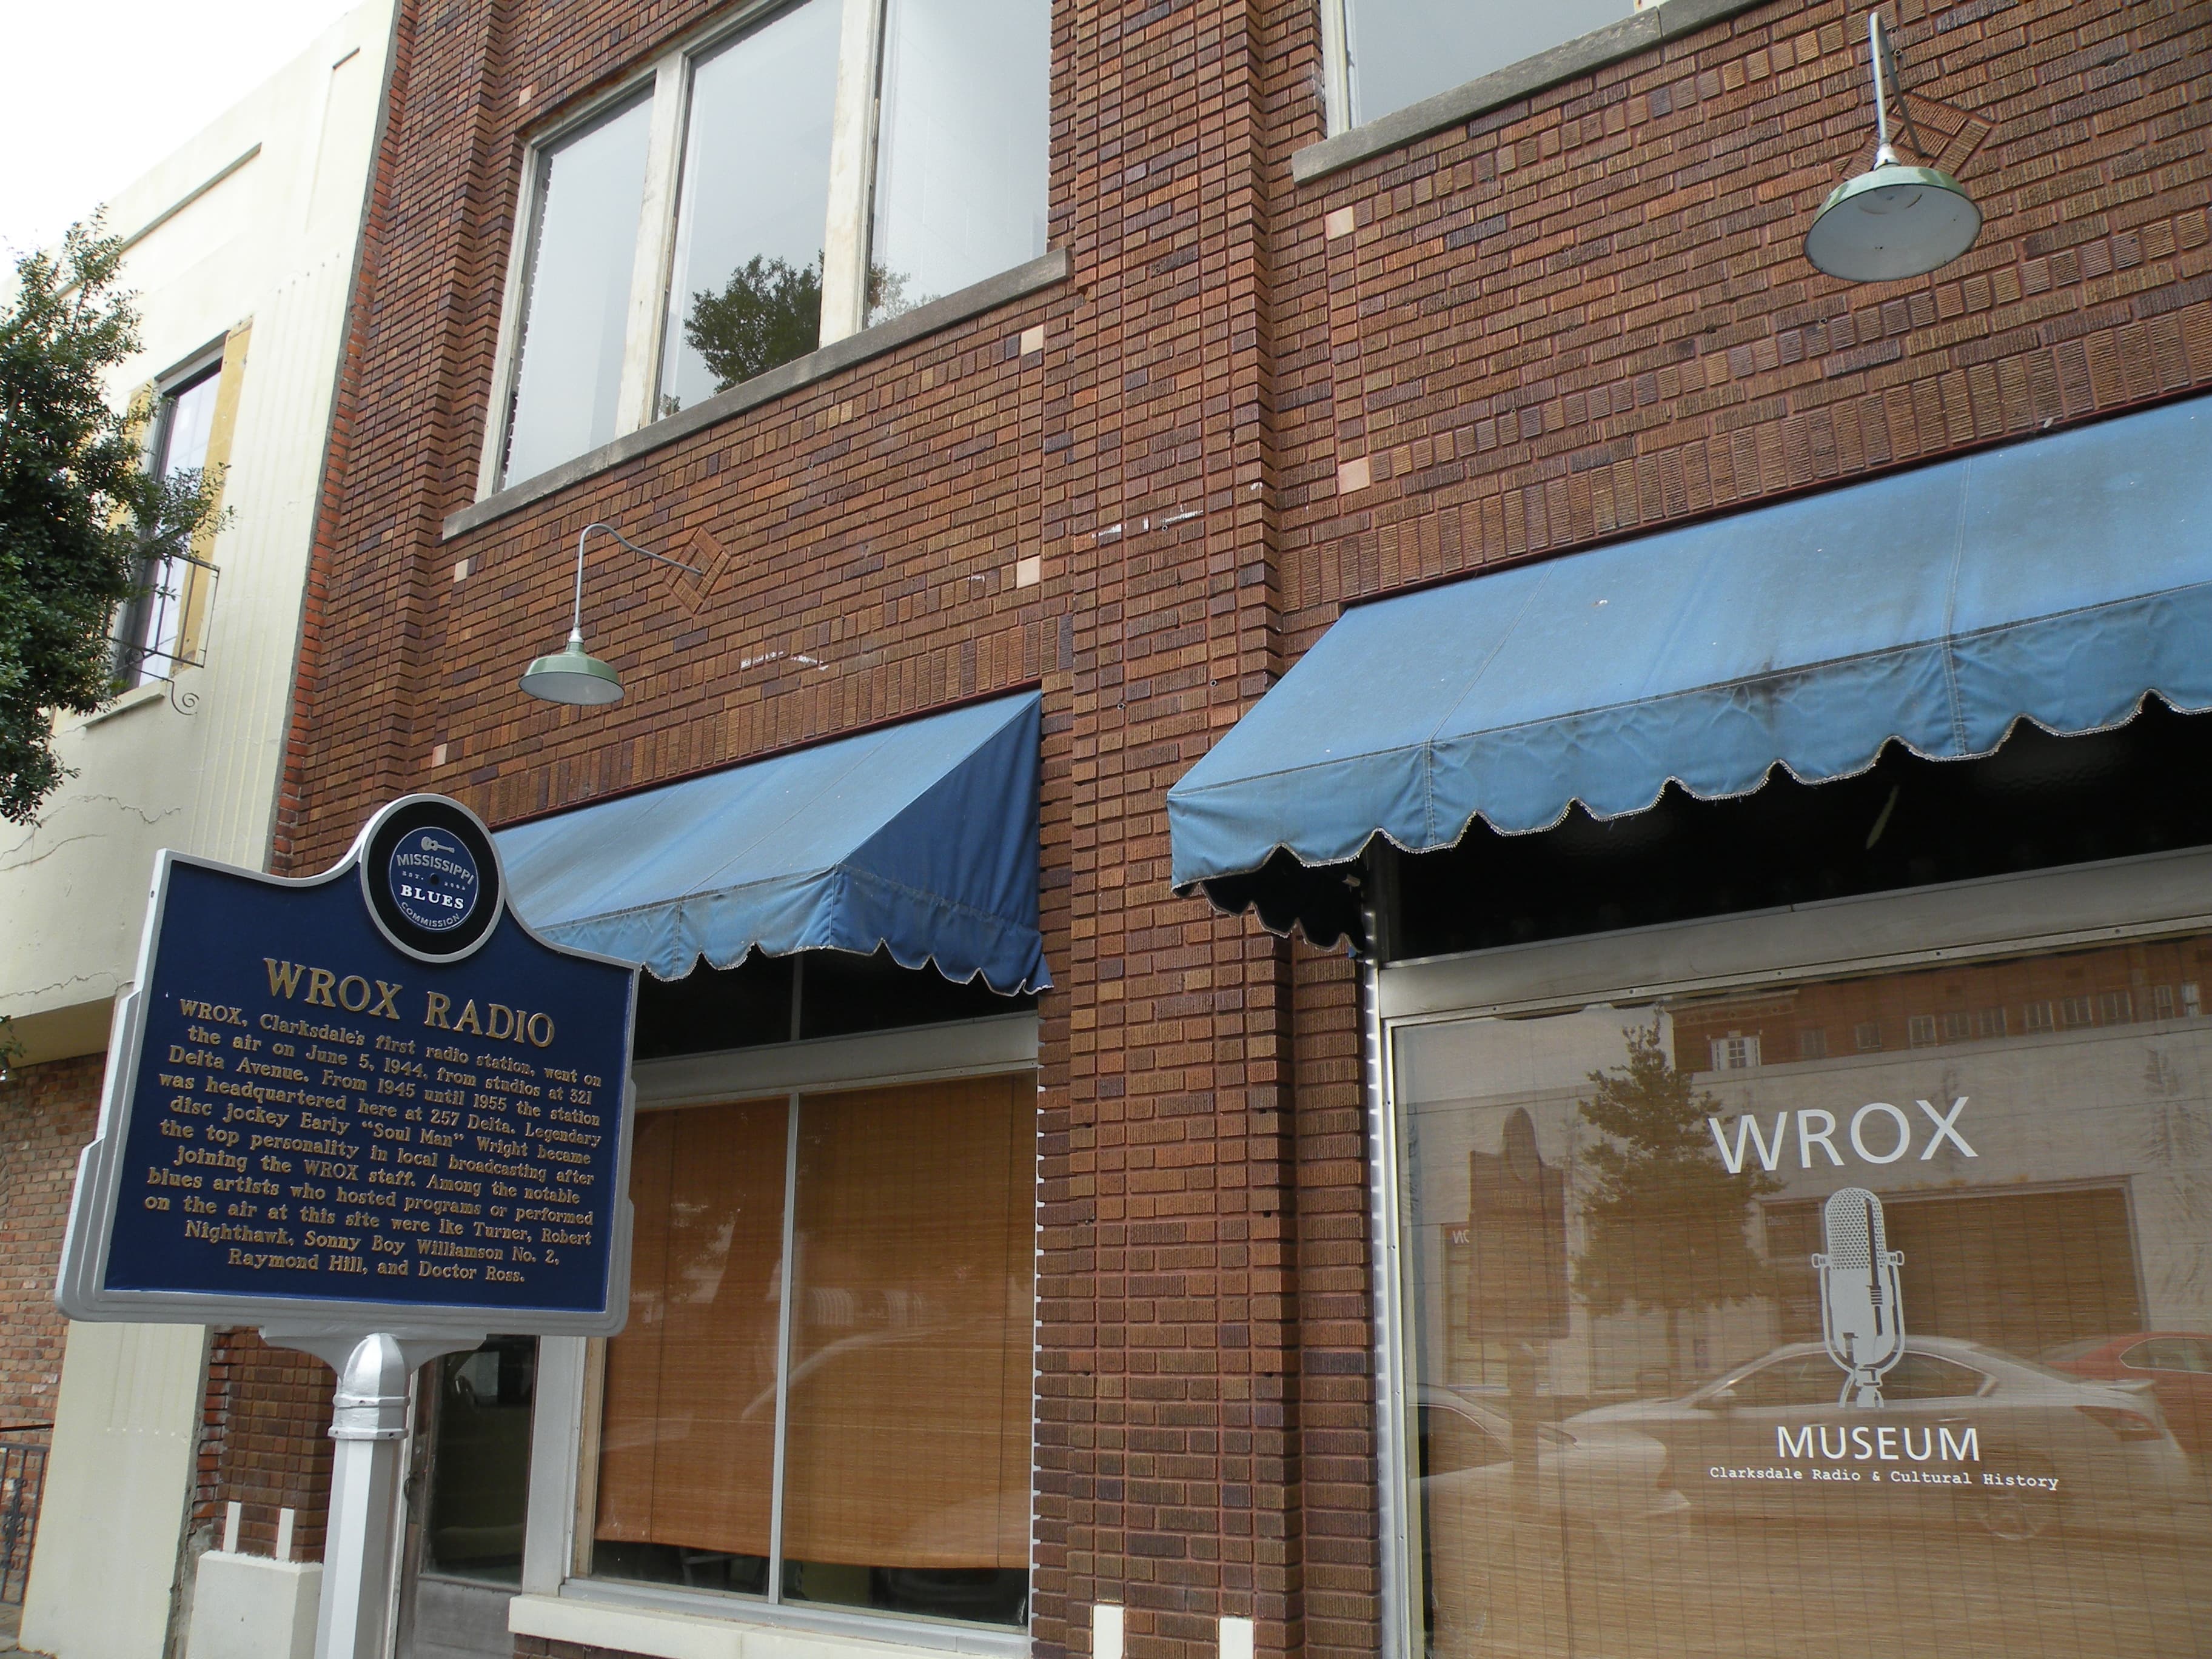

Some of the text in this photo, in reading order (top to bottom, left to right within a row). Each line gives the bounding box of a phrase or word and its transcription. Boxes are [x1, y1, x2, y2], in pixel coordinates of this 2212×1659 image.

[397, 854, 474, 885] MISSISSIPPI
[400, 884, 464, 910] BLUES
[401, 902, 460, 927] COMMISSION
[263, 957, 555, 1048] WROX RADIO
[179, 997, 602, 1087] WROX, Clarksdale's first radio station, went on
[187, 1024, 592, 1105] the air on June 5, 1944, from studios at 321
[158, 1073, 602, 1148] was headquartered here at 257 Delta. Legendary
[167, 1044, 600, 1126] Delta Avenue. From 1945 until 1955 the station
[159, 1118, 594, 1185] the top personality in local broadcasting after
[169, 1094, 212, 1116] disc
[221, 1102, 290, 1128] jockey
[299, 1111, 350, 1136] Early
[476, 1135, 528, 1158] Wright
[536, 1144, 591, 1165] became
[1708, 1096, 1979, 1174] WROX
[146, 1166, 593, 1225] blues artists who hosted programs or performed
[172, 1144, 580, 1204] joining the WROX staff. Among the notable
[144, 1195, 592, 1245] on the air at this site were Ike Turner, Robert
[184, 1219, 559, 1265] Nighthawk, Sonny Boy Williamson No. 2,
[227, 1247, 525, 1282] Raymond Hill, and Doctor Ross.
[1777, 1426, 1980, 1462] MUSEUM
[1709, 1466, 2059, 1491] Clarksdale Radio & Cultural History
